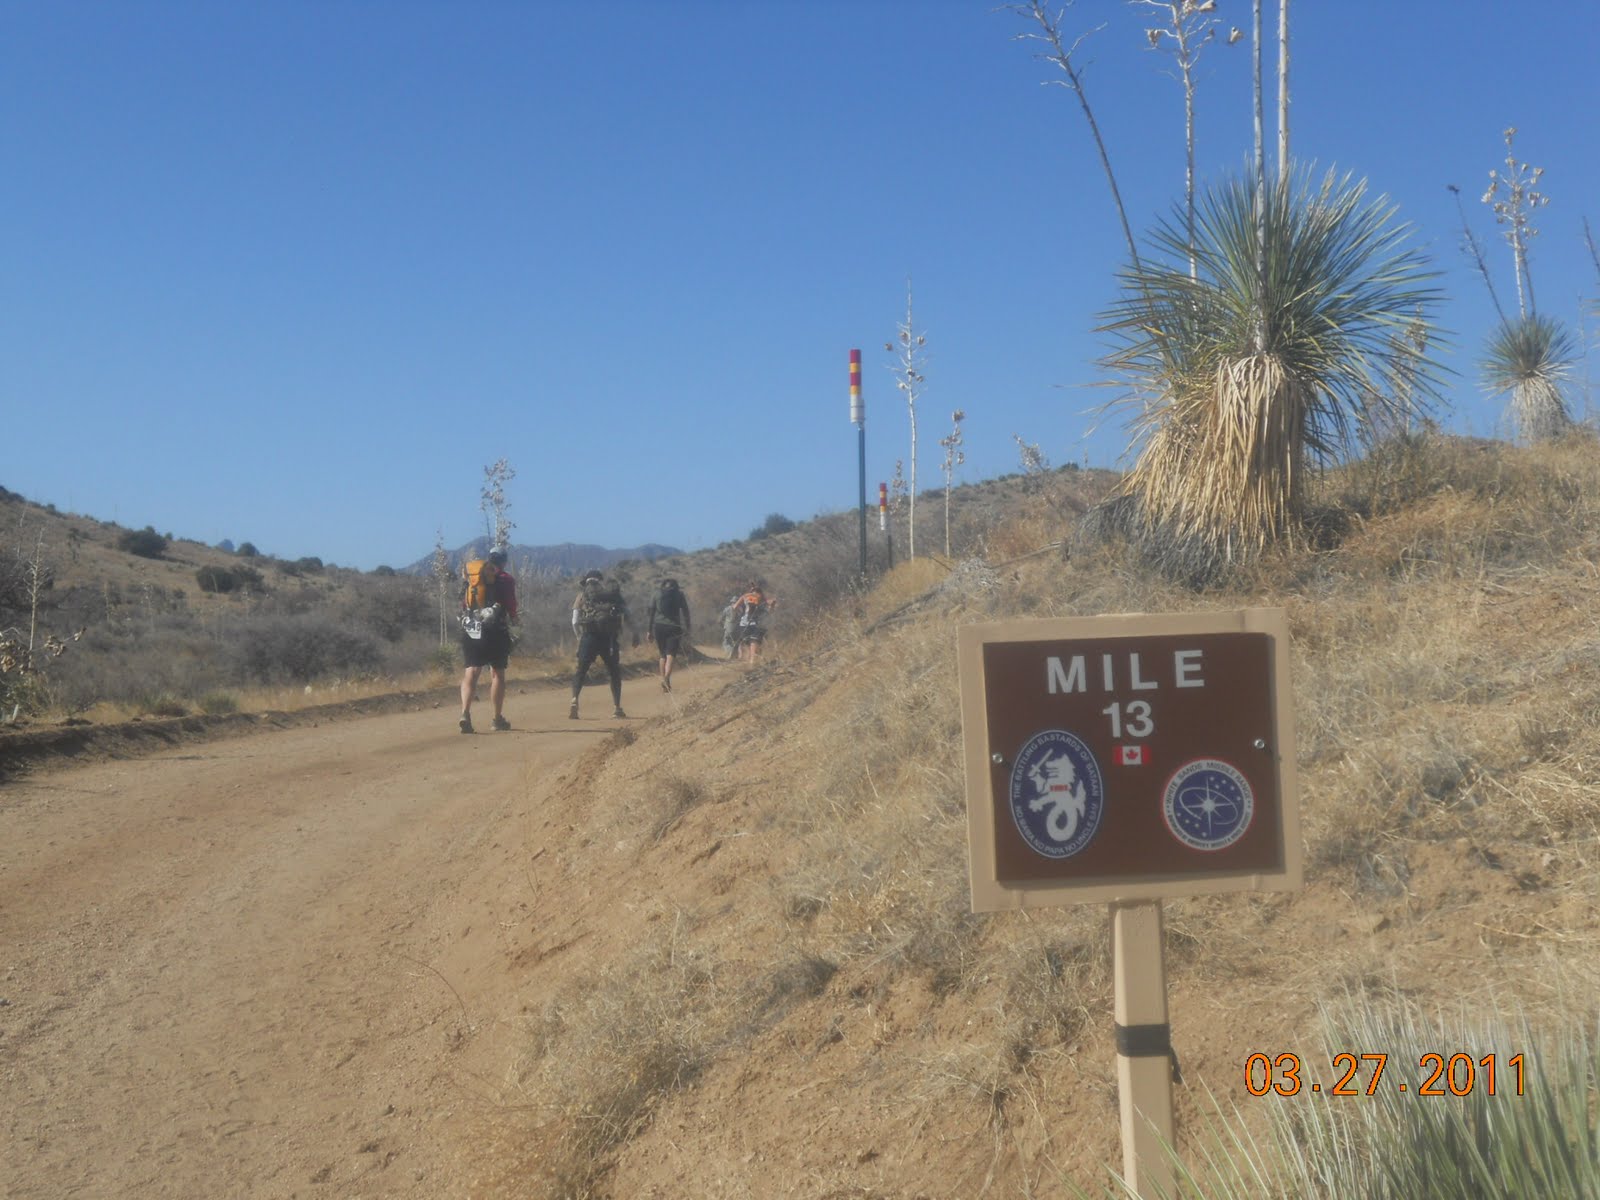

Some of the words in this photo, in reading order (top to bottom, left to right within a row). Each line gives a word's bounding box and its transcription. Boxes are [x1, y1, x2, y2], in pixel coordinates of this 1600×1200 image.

[1047, 650, 1205, 694] MILE
[1102, 700, 1154, 738] 13
[1037, 734, 1081, 752] BASTARDS
[1080, 750, 1090, 762] OF
[1015, 743, 1038, 781] BATTLING
[1177, 762, 1202, 780] SANDS
[1013, 781, 1021, 798] THE
[1086, 763, 1099, 797] BATAAN
